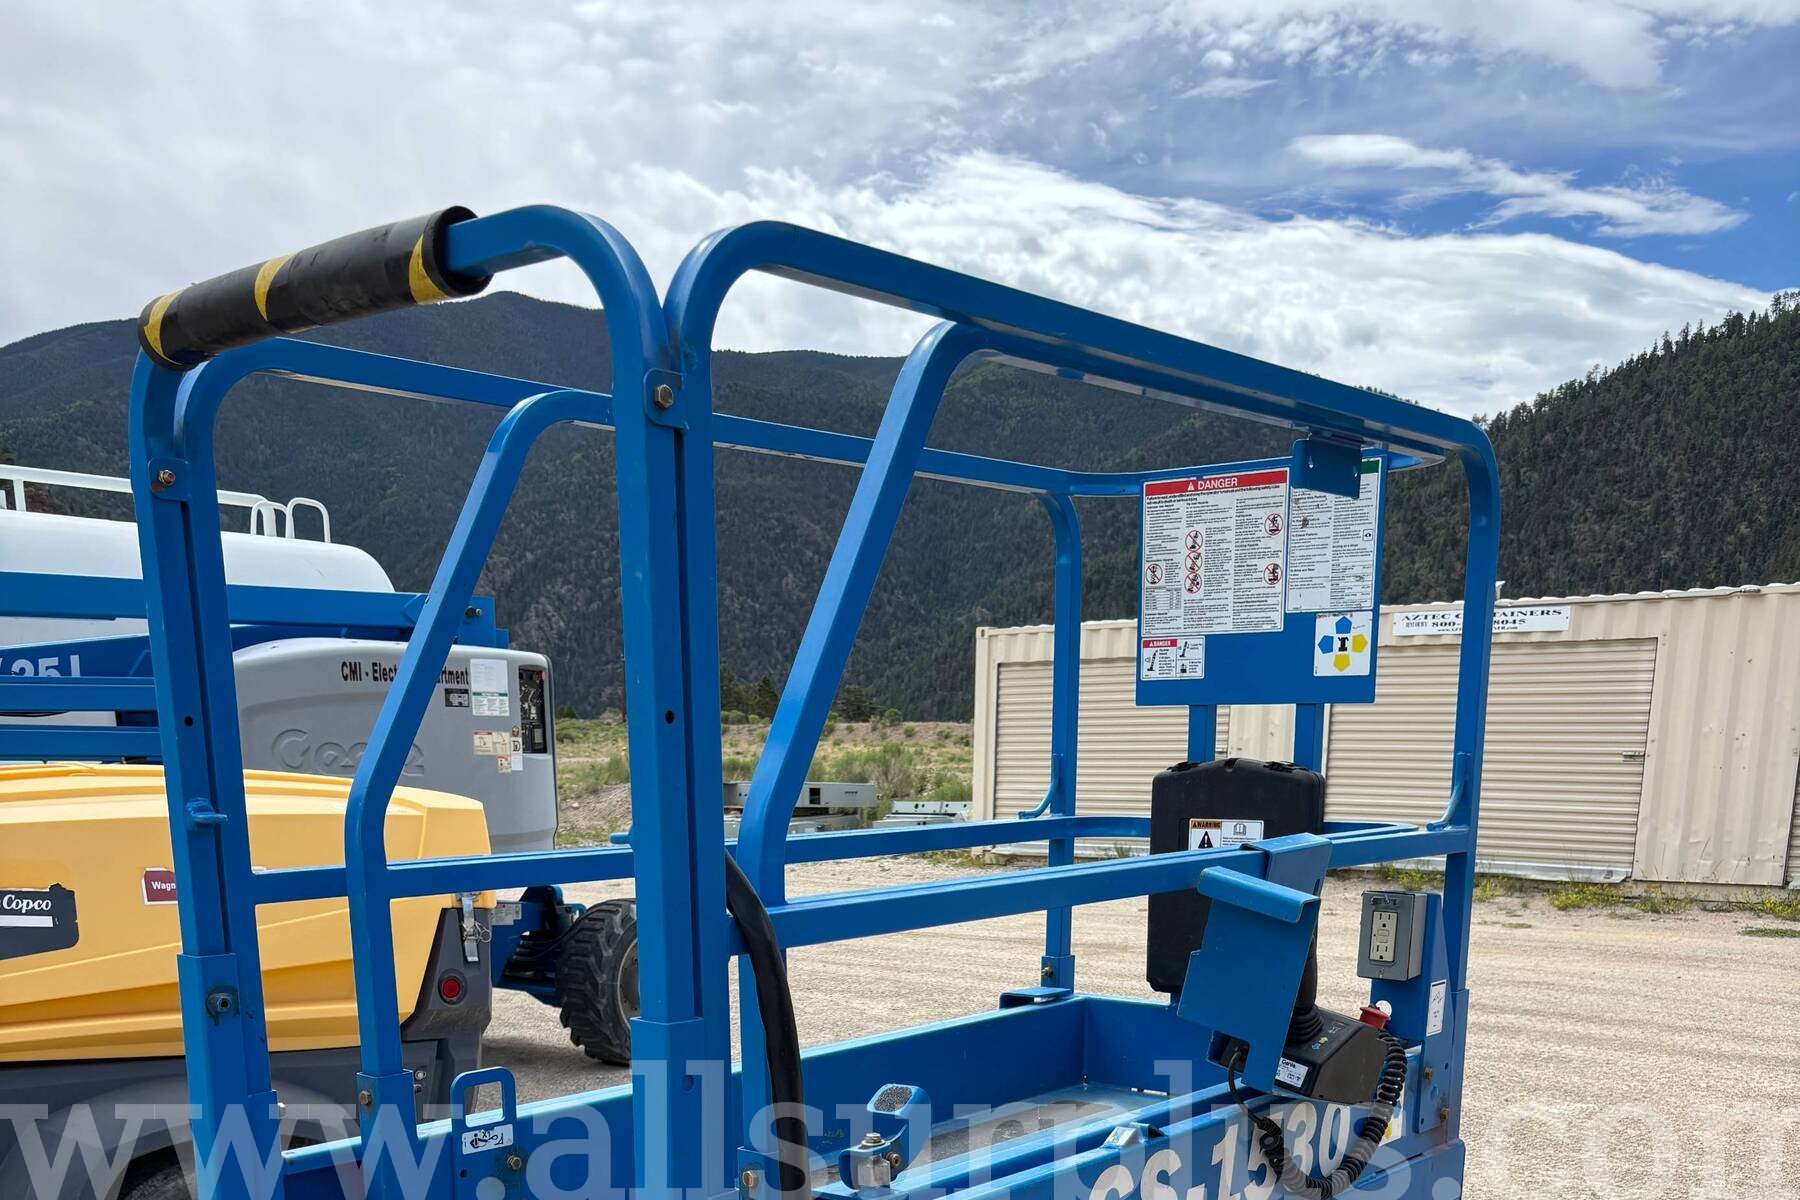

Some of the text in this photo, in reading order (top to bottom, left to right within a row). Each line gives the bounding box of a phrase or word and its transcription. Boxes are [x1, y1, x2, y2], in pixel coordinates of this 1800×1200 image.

[1198, 478, 1238, 490] DANGER
[1401, 613, 1450, 621] AZTEC
[341, 661, 362, 681] CMI
[3, 894, 52, 913] Copco
